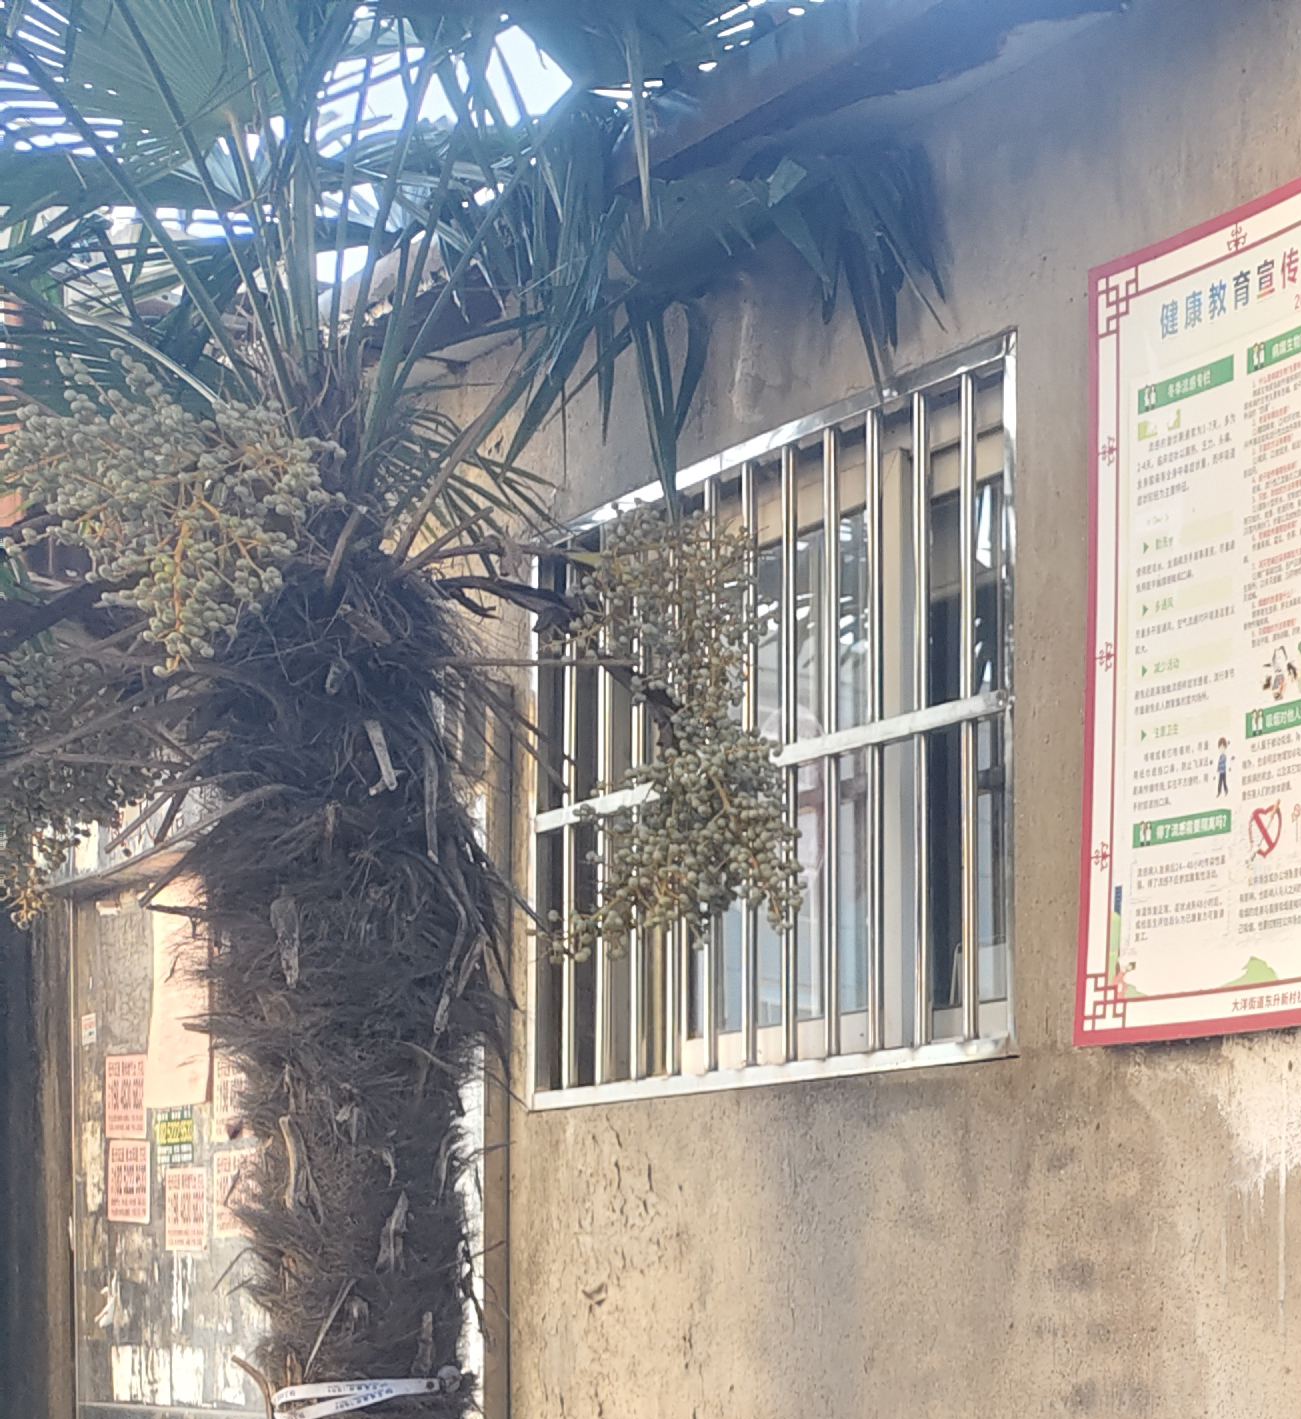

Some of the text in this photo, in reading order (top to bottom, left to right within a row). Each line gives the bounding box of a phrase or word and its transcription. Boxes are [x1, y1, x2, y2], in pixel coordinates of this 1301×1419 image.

[1167, 370, 1212, 398] 冬季流感专栏
